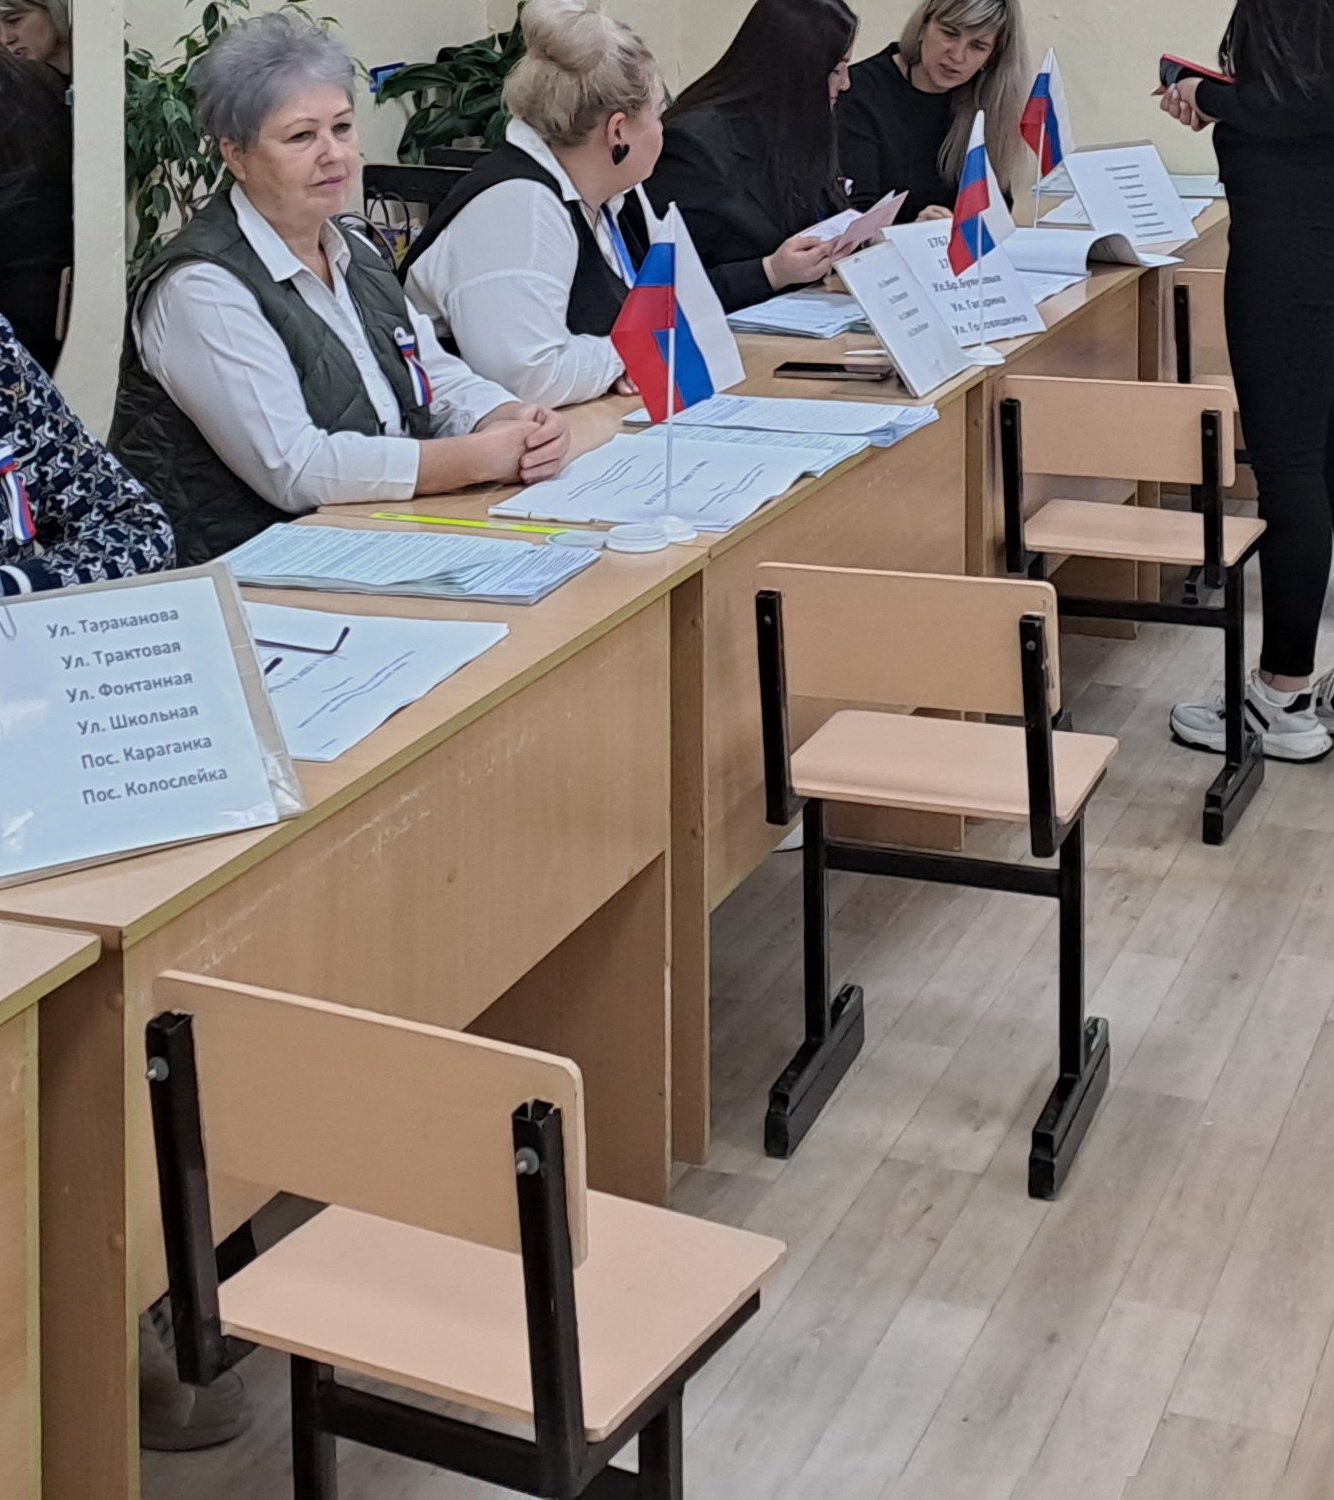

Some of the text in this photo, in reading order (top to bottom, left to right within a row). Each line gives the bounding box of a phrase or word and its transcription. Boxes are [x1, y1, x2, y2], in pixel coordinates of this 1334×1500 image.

[47, 608, 180, 638] Ул. Тараканова
[61, 641, 181, 670] Ул. Трактовая
[65, 672, 193, 703] Ул. Фонтанная
[77, 704, 199, 736] Ул. Школьная
[81, 736, 213, 770] Пос. Караганка
[82, 768, 228, 805] Пос. Колослейка
